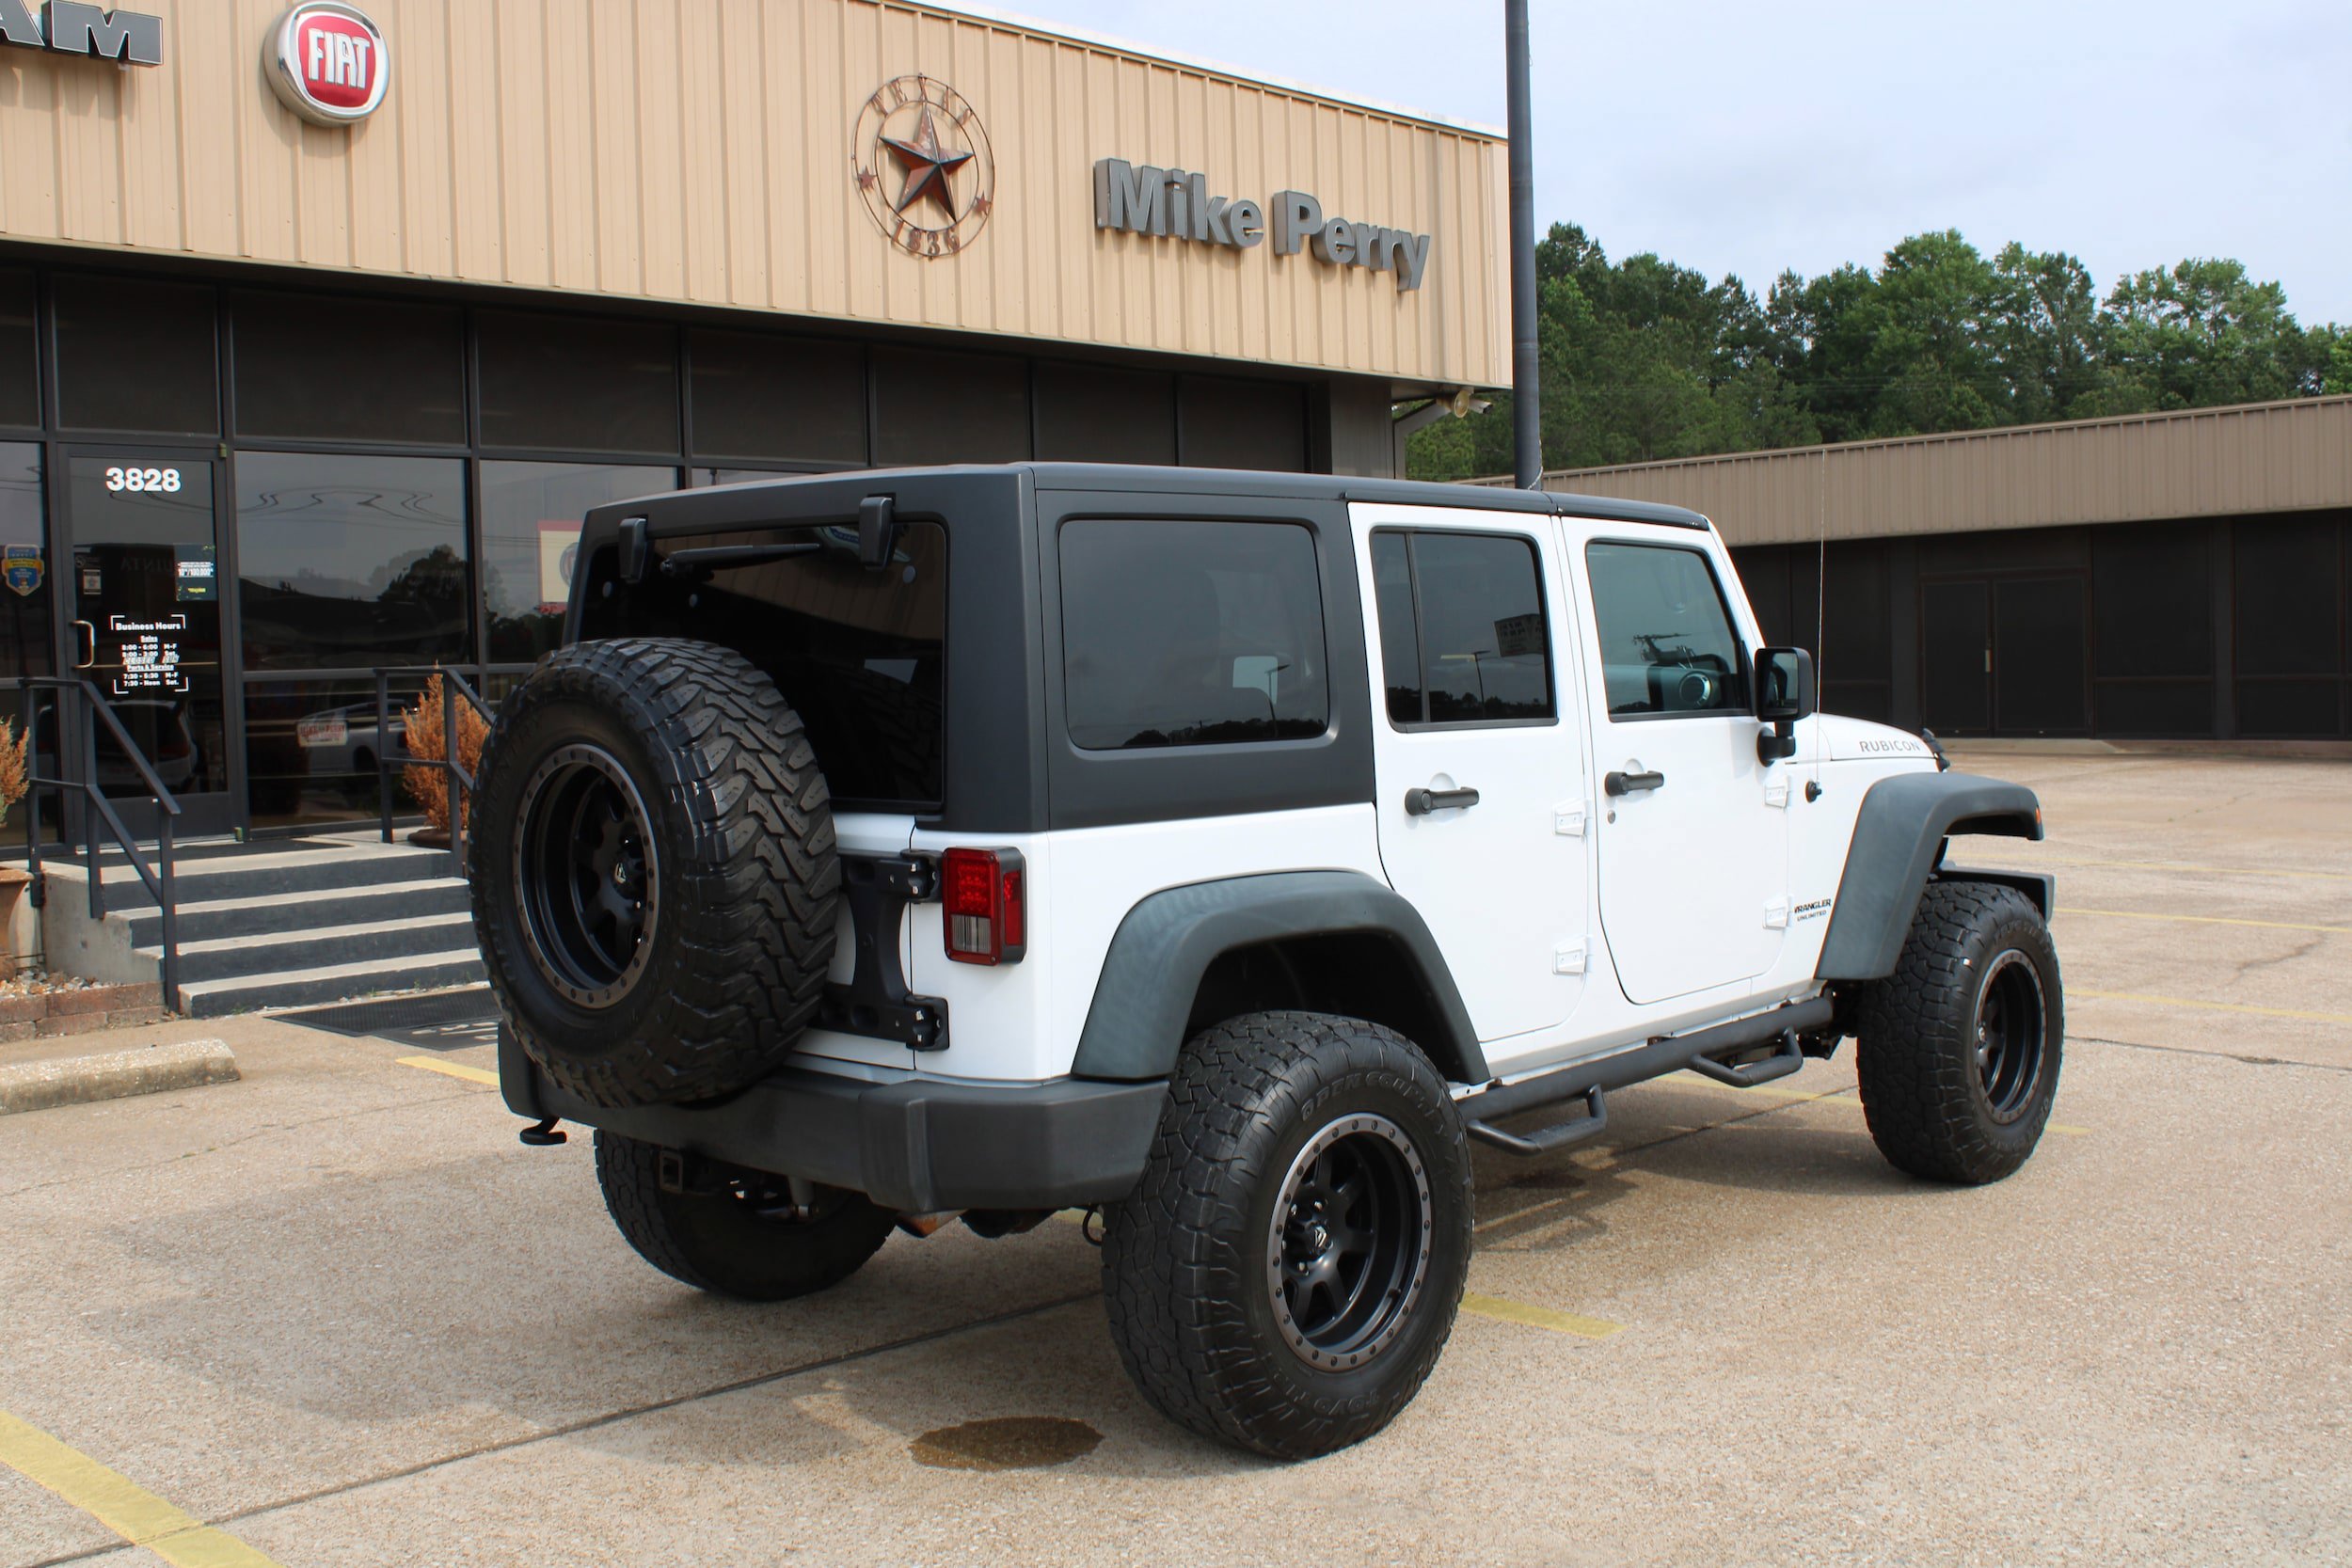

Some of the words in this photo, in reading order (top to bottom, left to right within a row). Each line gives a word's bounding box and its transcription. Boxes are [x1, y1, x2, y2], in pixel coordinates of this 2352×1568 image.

[308, 27, 371, 90] FIAT
[1093, 157, 1264, 250] Mike
[1273, 190, 1431, 292] Perry
[105, 467, 182, 492] 3828
[115, 622, 154, 630] Business
[155, 622, 182, 630] Hours
[1859, 739, 1921, 752] RUBICON
[1794, 898, 1831, 913] WRANGLER
[1300, 1072, 1361, 1122] OPEN
